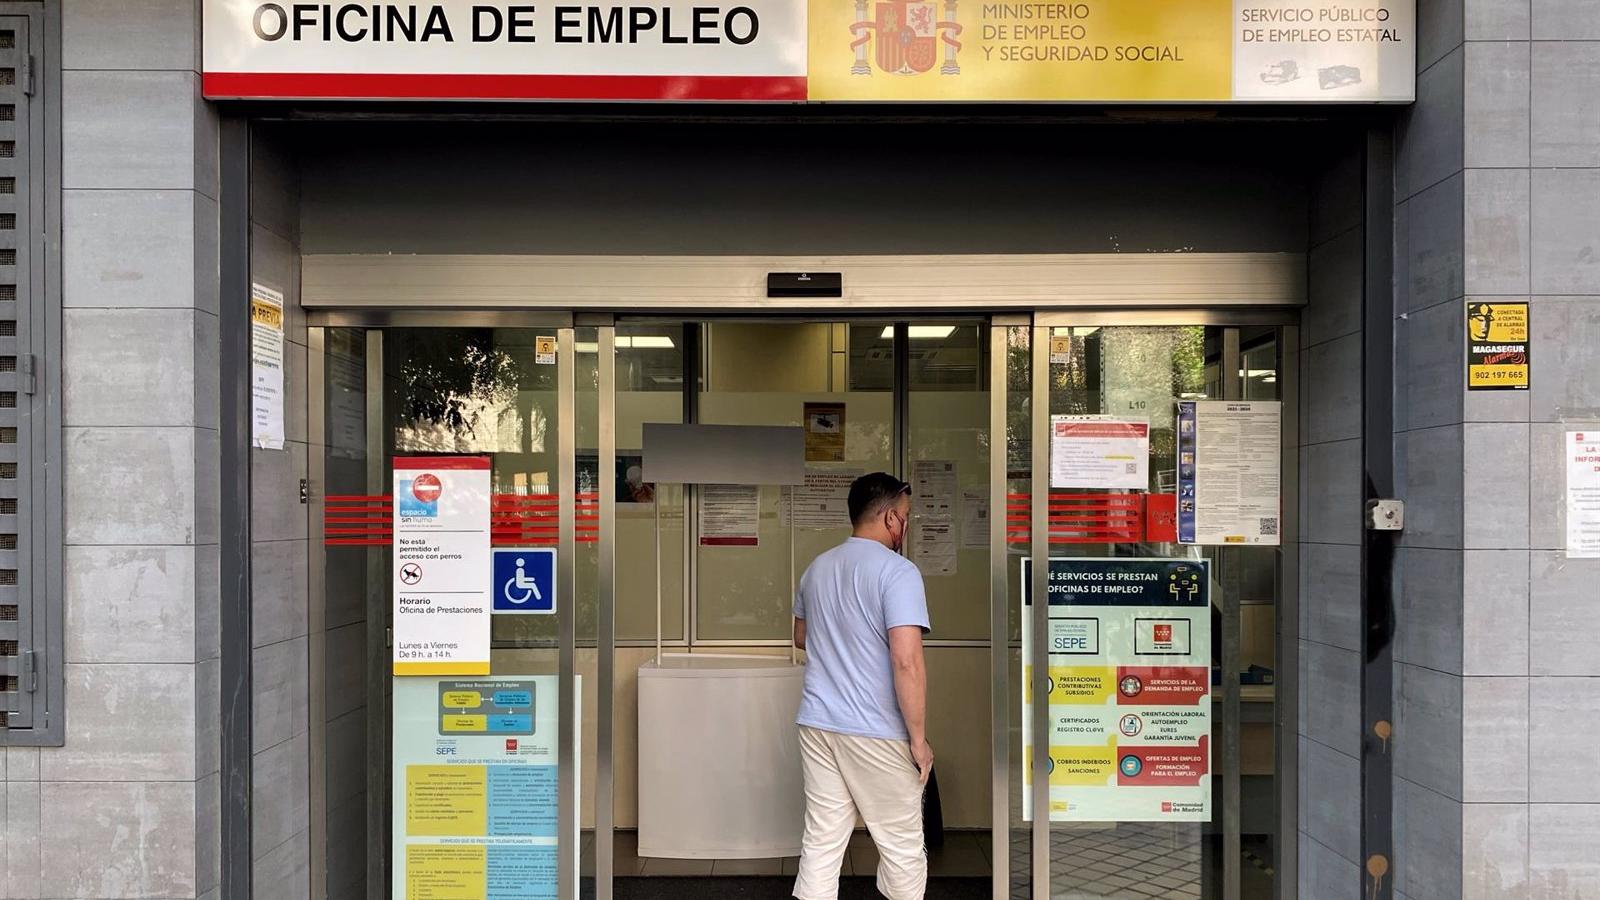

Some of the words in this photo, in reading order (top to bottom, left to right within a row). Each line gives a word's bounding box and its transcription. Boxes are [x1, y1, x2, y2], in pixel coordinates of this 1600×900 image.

[983, 4, 1089, 19] MINISTERIO
[1242, 9, 1314, 23] SERVICIO
[1320, 5, 1390, 23] PÚBLICO
[252, 2, 454, 43] OFICINA
[472, 4, 535, 43] DE
[554, 5, 760, 45] EMPLEO
[983, 25, 1007, 40] DE
[1014, 25, 1086, 40] EMPLEO
[1243, 29, 1265, 42] DE
[1270, 29, 1331, 42] EMPLEO
[1337, 29, 1401, 42] ESTATAL
[983, 46, 995, 61] Y
[999, 46, 1108, 61] SEGURIDAD
[1115, 46, 1184, 61] SOCIAL
[1472, 345, 1525, 353] MAGASEGUR
[401, 509, 427, 517] espacio
[1048, 585, 1089, 593] OFICINAS
[1091, 585, 1102, 593] DE
[1054, 637, 1087, 648] SEPE
